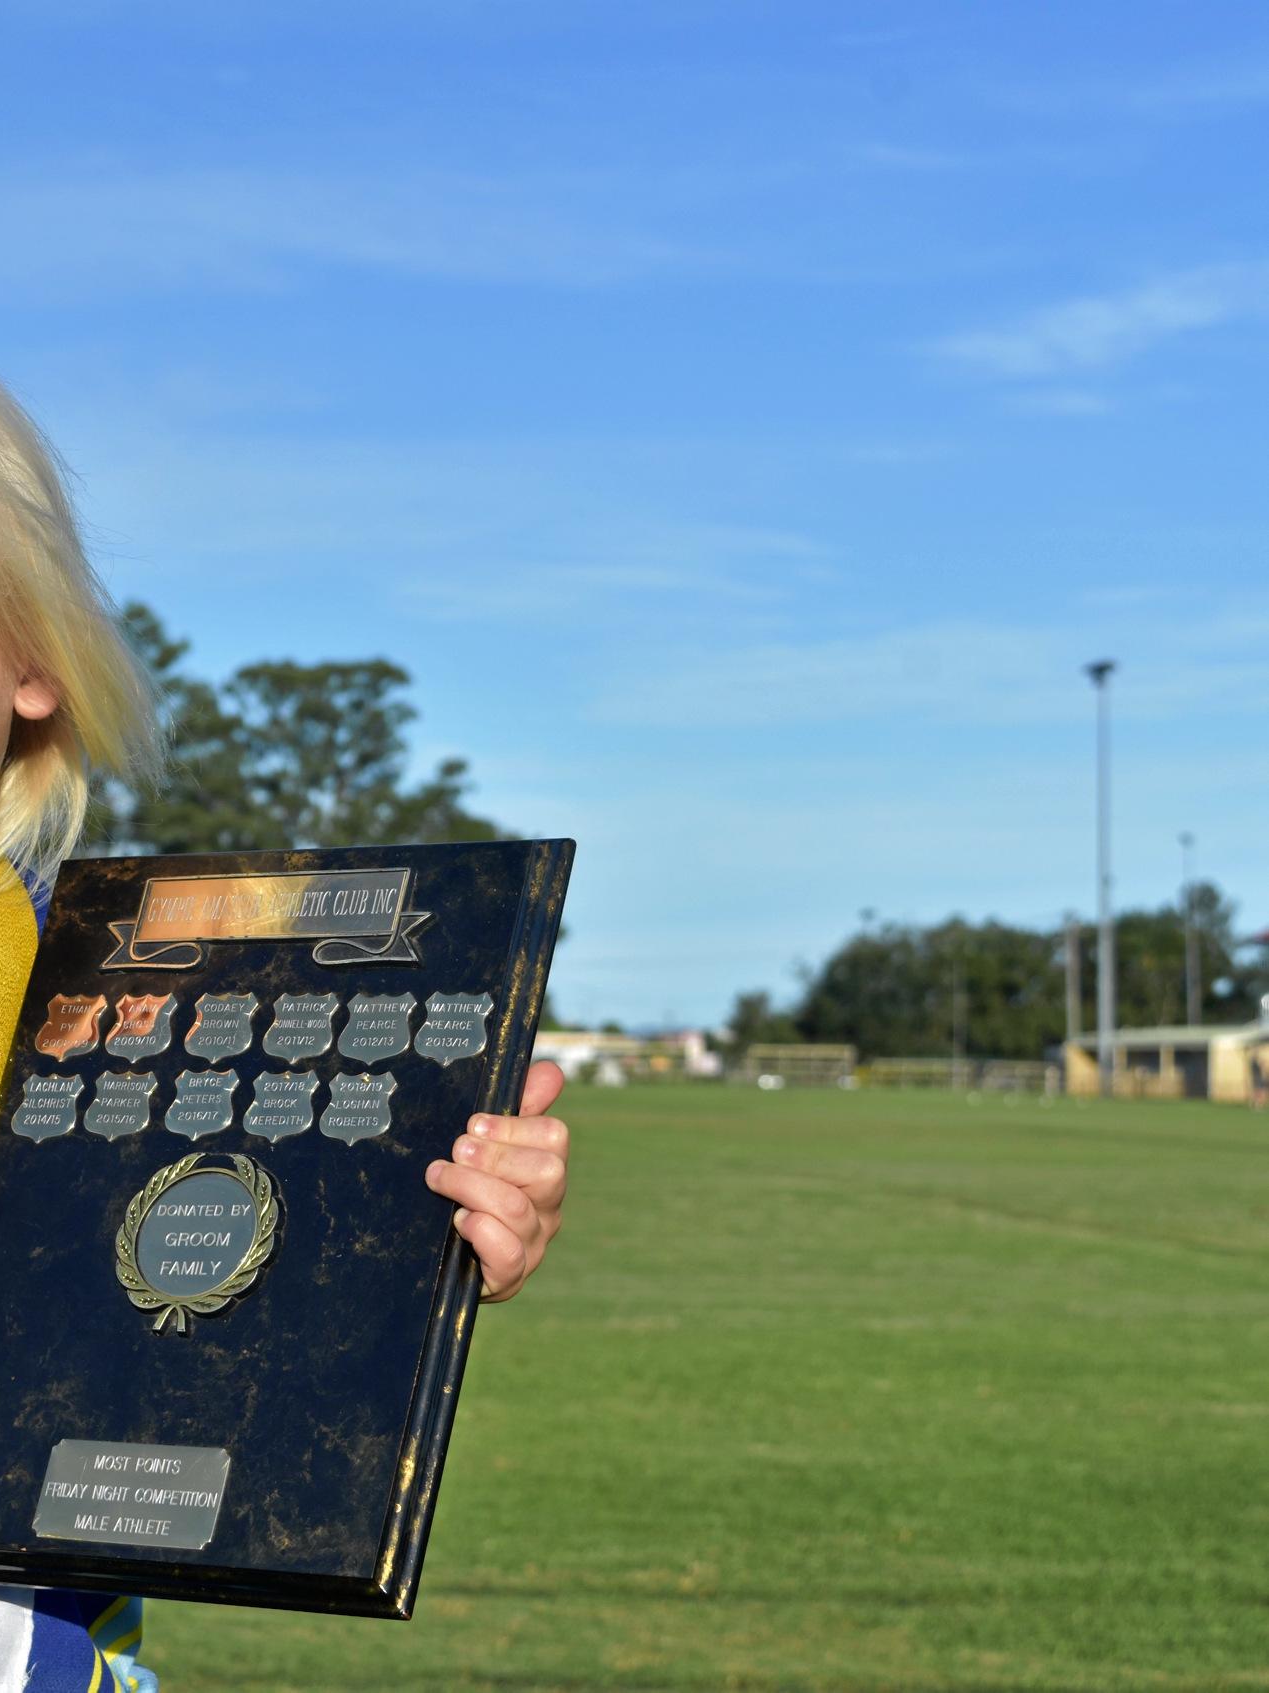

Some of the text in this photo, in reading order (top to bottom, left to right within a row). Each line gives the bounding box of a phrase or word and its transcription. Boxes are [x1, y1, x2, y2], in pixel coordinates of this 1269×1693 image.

[332, 889, 368, 916] CLUB
[371, 888, 397, 914] INC
[282, 1003, 327, 1013] PATRICK
[353, 1003, 409, 1013] MATTHEW
[431, 1003, 483, 1013] MATTHEW
[202, 1020, 239, 1030] BROWN
[356, 1020, 397, 1030] PEARCE
[430, 1020, 474, 1030] PEARCE
[114, 1036, 157, 1046] 2009/10
[277, 1036, 315, 1046] 2011/12
[352, 1036, 395, 1047] 2012/13
[425, 1037, 469, 1047] 2013/14
[30, 1082, 73, 1092] LACHLAN
[103, 1081, 148, 1092] HARRISON
[189, 1078, 222, 1088] BRYCE
[264, 1082, 306, 1092] 2017/18
[101, 1098, 140, 1108] PARKER
[182, 1095, 221, 1105] PETERS
[263, 1099, 298, 1108] BROCK
[335, 1100, 380, 1109] LOGHAN
[23, 1114, 61, 1125] 2014/15
[96, 1114, 136, 1124] 2015/16
[178, 1111, 219, 1121] 2016/17
[249, 1116, 304, 1126] MEREDITH
[328, 1117, 378, 1127] ROBERTS
[157, 1204, 251, 1217] DONATED BY
[165, 1232, 231, 1247] GROOM
[159, 1261, 222, 1276] FAMILY
[93, 1455, 181, 1475] MOST POINTS
[44, 1482, 218, 1508] FRIDAY NIGHT COMPETITION
[74, 1514, 171, 1535] MALE ATHLETE
